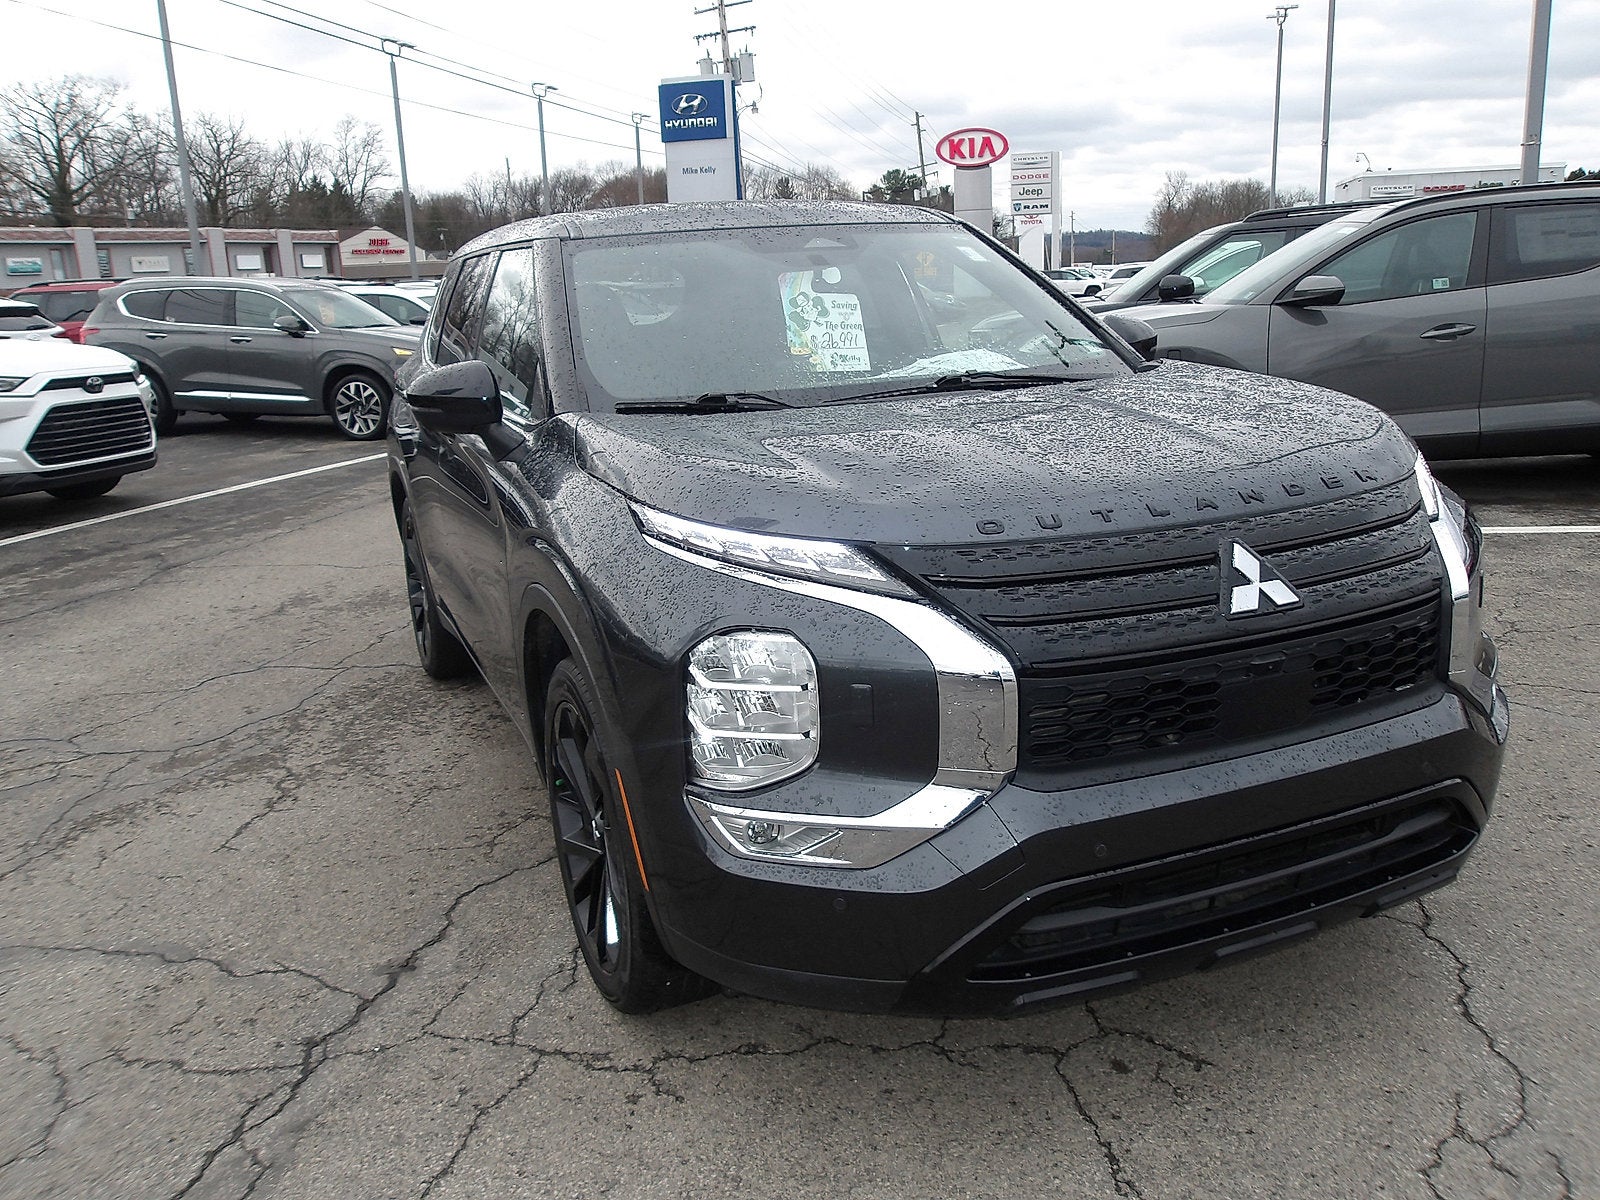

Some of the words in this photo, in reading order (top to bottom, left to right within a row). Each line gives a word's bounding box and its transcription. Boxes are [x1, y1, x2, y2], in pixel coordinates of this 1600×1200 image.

[665, 117, 718, 129] HYUNDAI
[948, 136, 997, 160] KIA
[682, 167, 698, 175] Mike
[699, 166, 717, 175] Kelly
[1018, 187, 1043, 197] Jeep
[1423, 184, 1466, 192] DODGE
[831, 300, 858, 311] Saving
[825, 321, 839, 331] The
[840, 320, 863, 331] Green
[976, 469, 1378, 534] OUTLANDER
